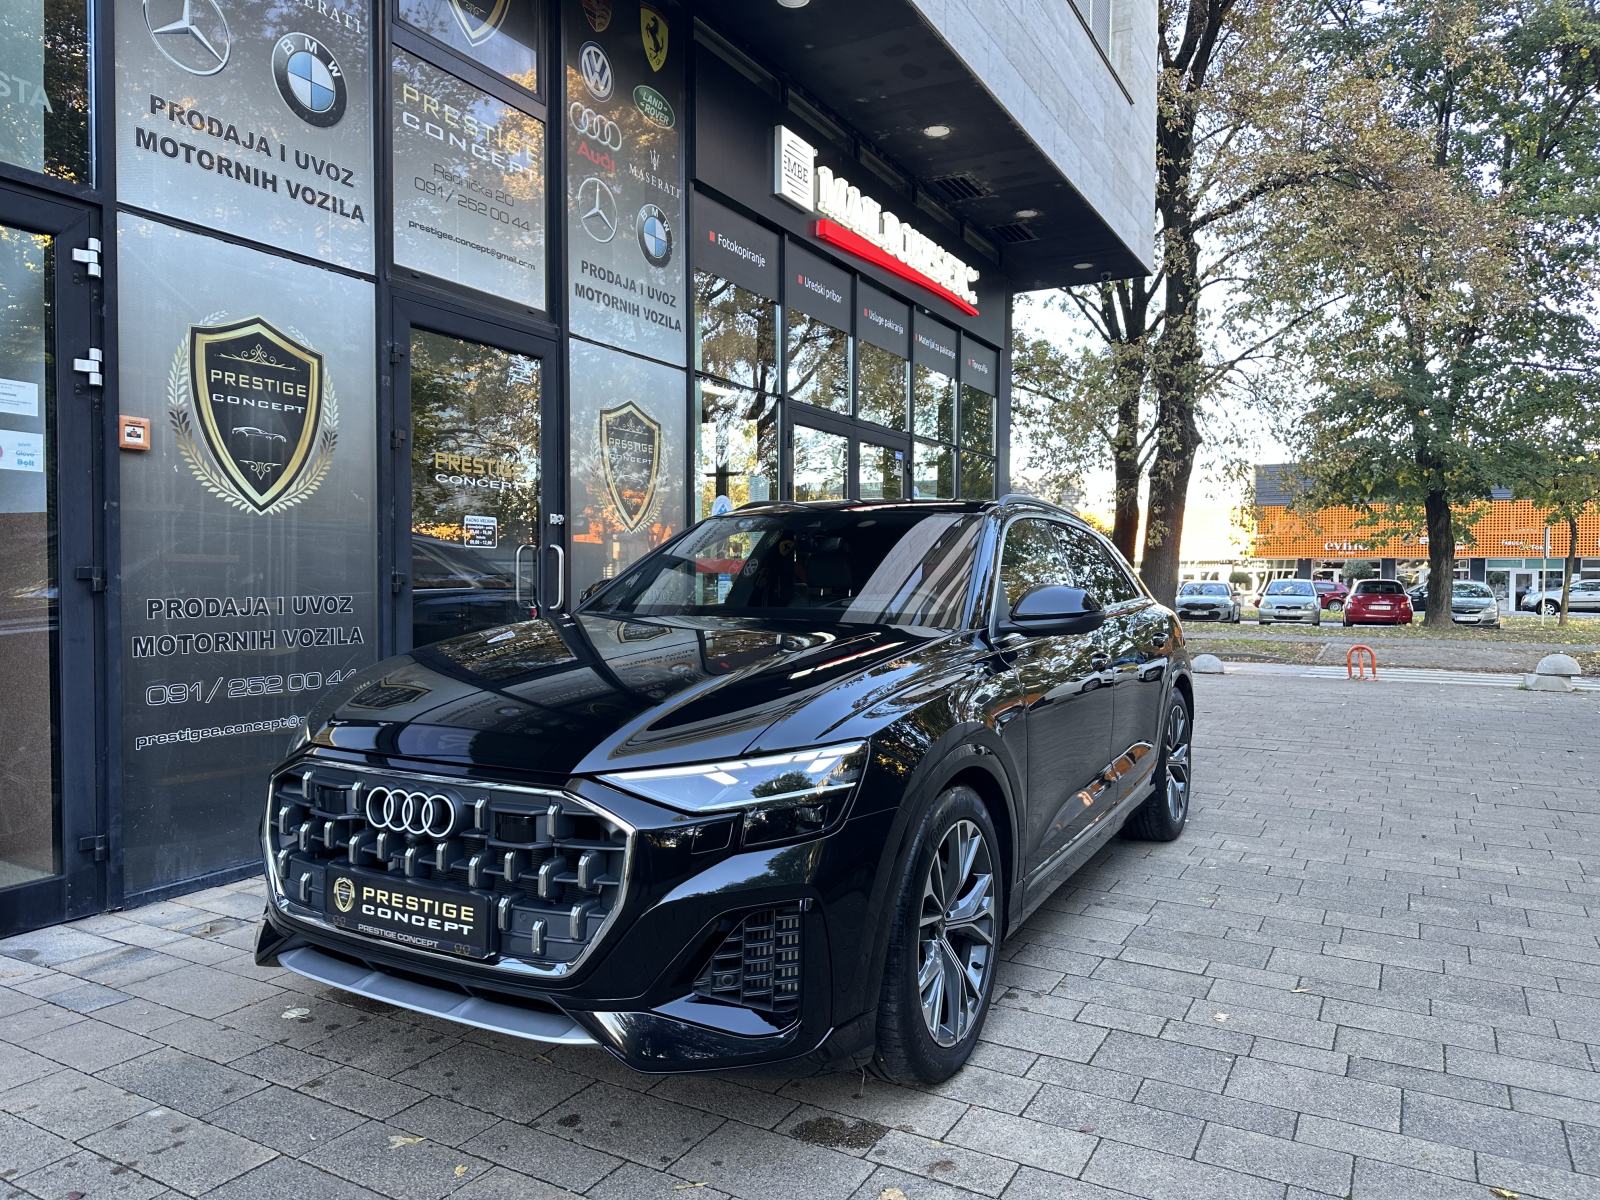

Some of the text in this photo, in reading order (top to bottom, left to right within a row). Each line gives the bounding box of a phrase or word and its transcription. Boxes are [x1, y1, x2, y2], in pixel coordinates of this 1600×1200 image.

[297, 0, 361, 34] ERATI
[280, 37, 341, 77] BMW
[642, 92, 664, 111] LAND
[645, 104, 670, 125] ROVER
[403, 83, 539, 166] PRESTIGE
[149, 93, 354, 187] PRODAJA I UVOZ
[403, 111, 538, 181] CONCEPT
[577, 141, 616, 173] Audi
[787, 157, 809, 184] MBE
[135, 126, 365, 223] MOTORNIH VOZILA
[629, 163, 680, 199] MASERATI
[458, 194, 487, 216] 252
[490, 207, 509, 224] 00
[512, 217, 530, 231] 44
[495, 189, 515, 207] 20
[640, 207, 670, 232] BMW
[718, 233, 766, 267] Fotokopiranje
[581, 260, 677, 308] PRODAJA I UVOZ
[804, 276, 842, 303] Uredski pribor
[575, 282, 682, 332] MOTORNIH VOZILA
[210, 369, 307, 398] PRESTIGE
[212, 393, 305, 414] CONCEPT
[609, 437, 654, 454] PRESTIGE
[610, 453, 653, 465] CONCEPT
[434, 451, 528, 480] PRESTIGE
[435, 473, 525, 491] CONCEPT
[147, 595, 353, 620] PRODAJA I UVOZ
[131, 626, 364, 658] MOTORNIH VOZILA
[227, 675, 283, 698] 252
[287, 671, 322, 692] 00
[362, 886, 474, 922] PRESTIGE
[361, 904, 474, 936] CONCEPT
[358, 923, 439, 949] PRESTIGE CONCEPT
